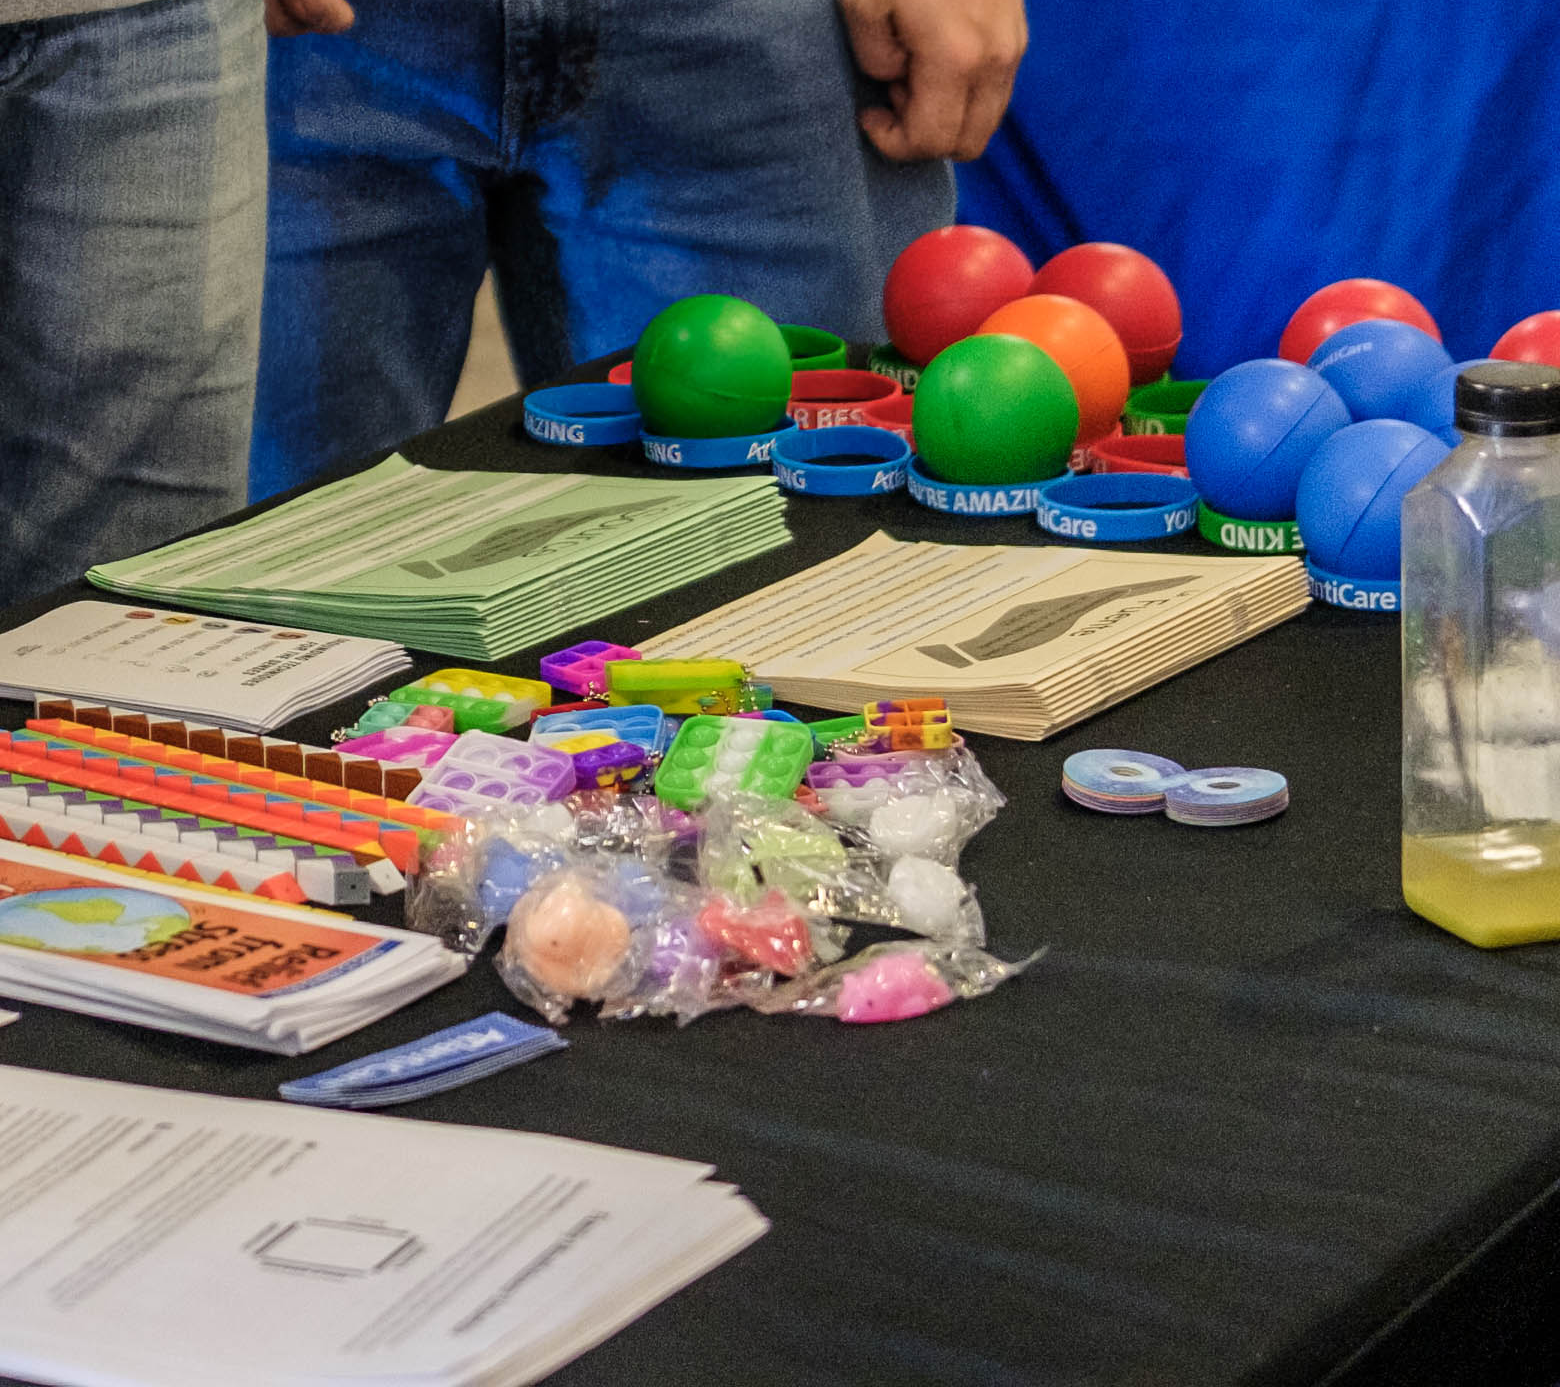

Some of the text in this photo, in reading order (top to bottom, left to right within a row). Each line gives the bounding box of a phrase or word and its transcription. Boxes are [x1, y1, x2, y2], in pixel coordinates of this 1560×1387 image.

[1036, 504, 1098, 539] tiCare
[1220, 522, 1285, 551] KIND
[1068, 598, 1171, 637] Fuente
